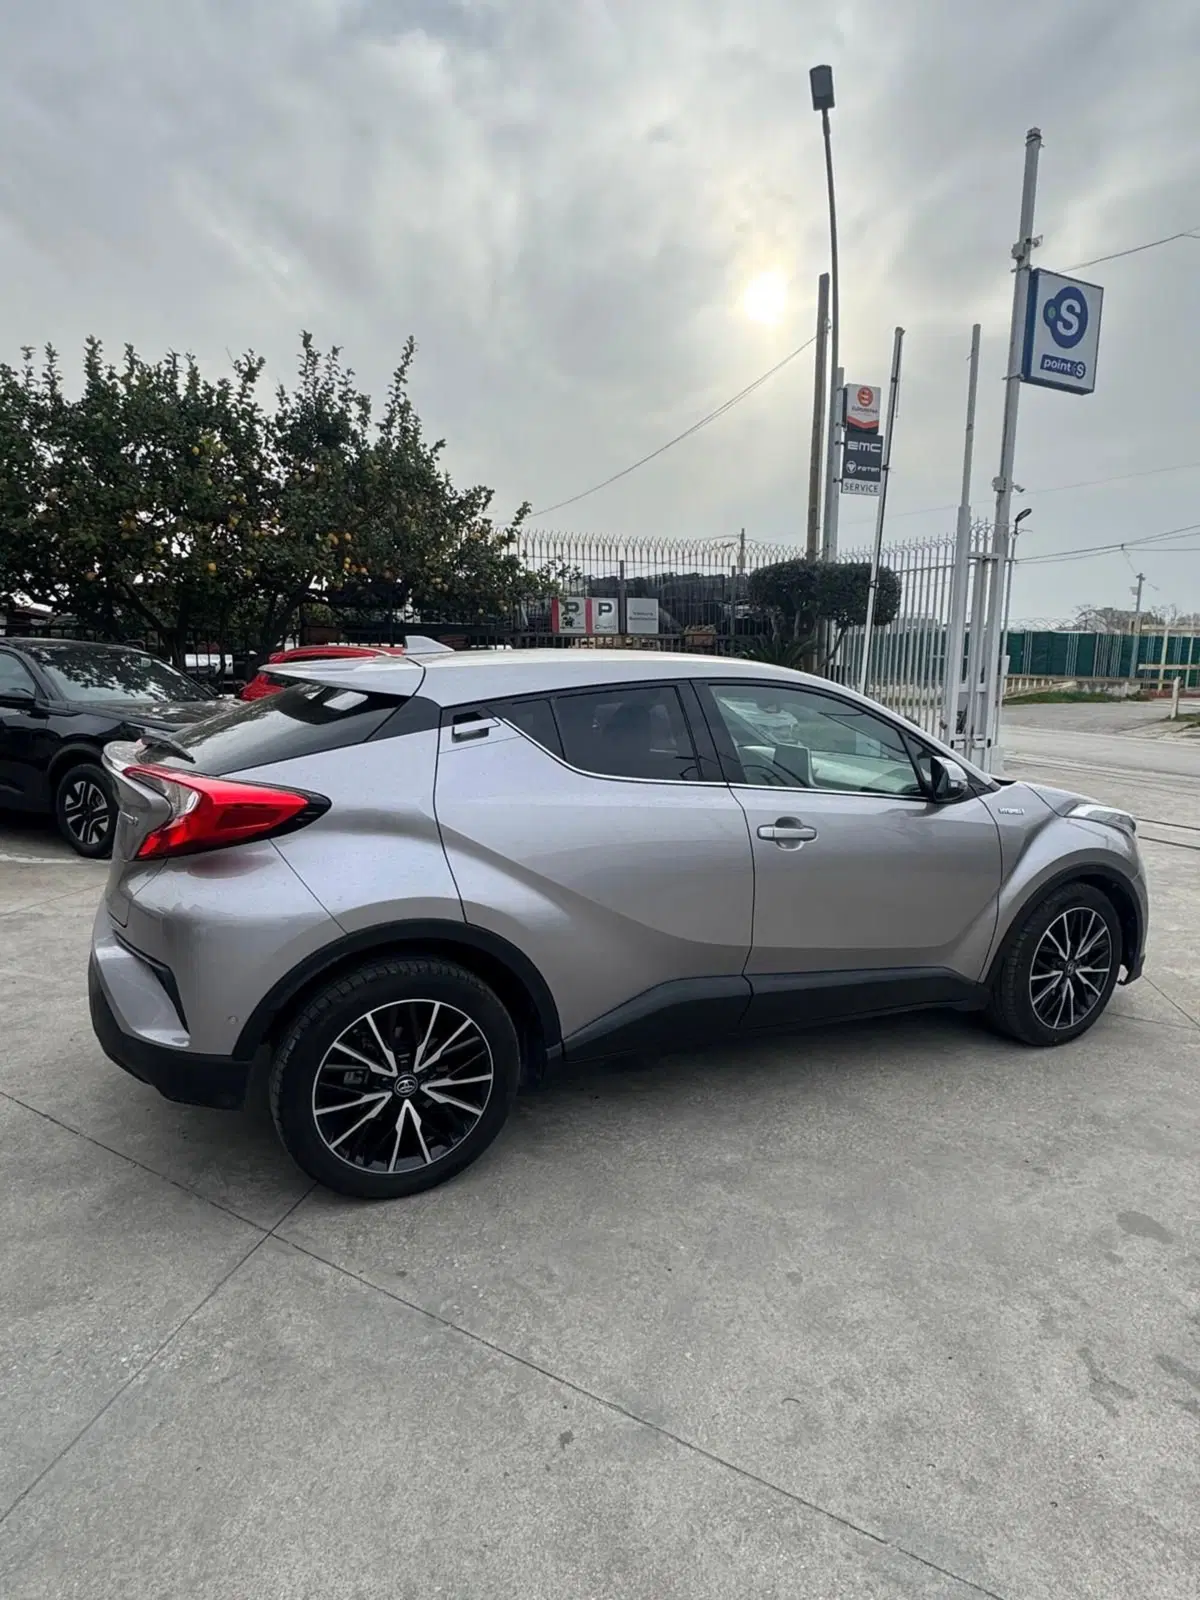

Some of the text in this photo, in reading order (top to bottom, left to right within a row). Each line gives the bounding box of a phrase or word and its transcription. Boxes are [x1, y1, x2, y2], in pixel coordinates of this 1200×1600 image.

[1056, 298, 1081, 336] S
[1044, 359, 1070, 371] point
[847, 440, 881, 453] EMC
[844, 482, 879, 493] SERVICE
[598, 602, 613, 616] P
